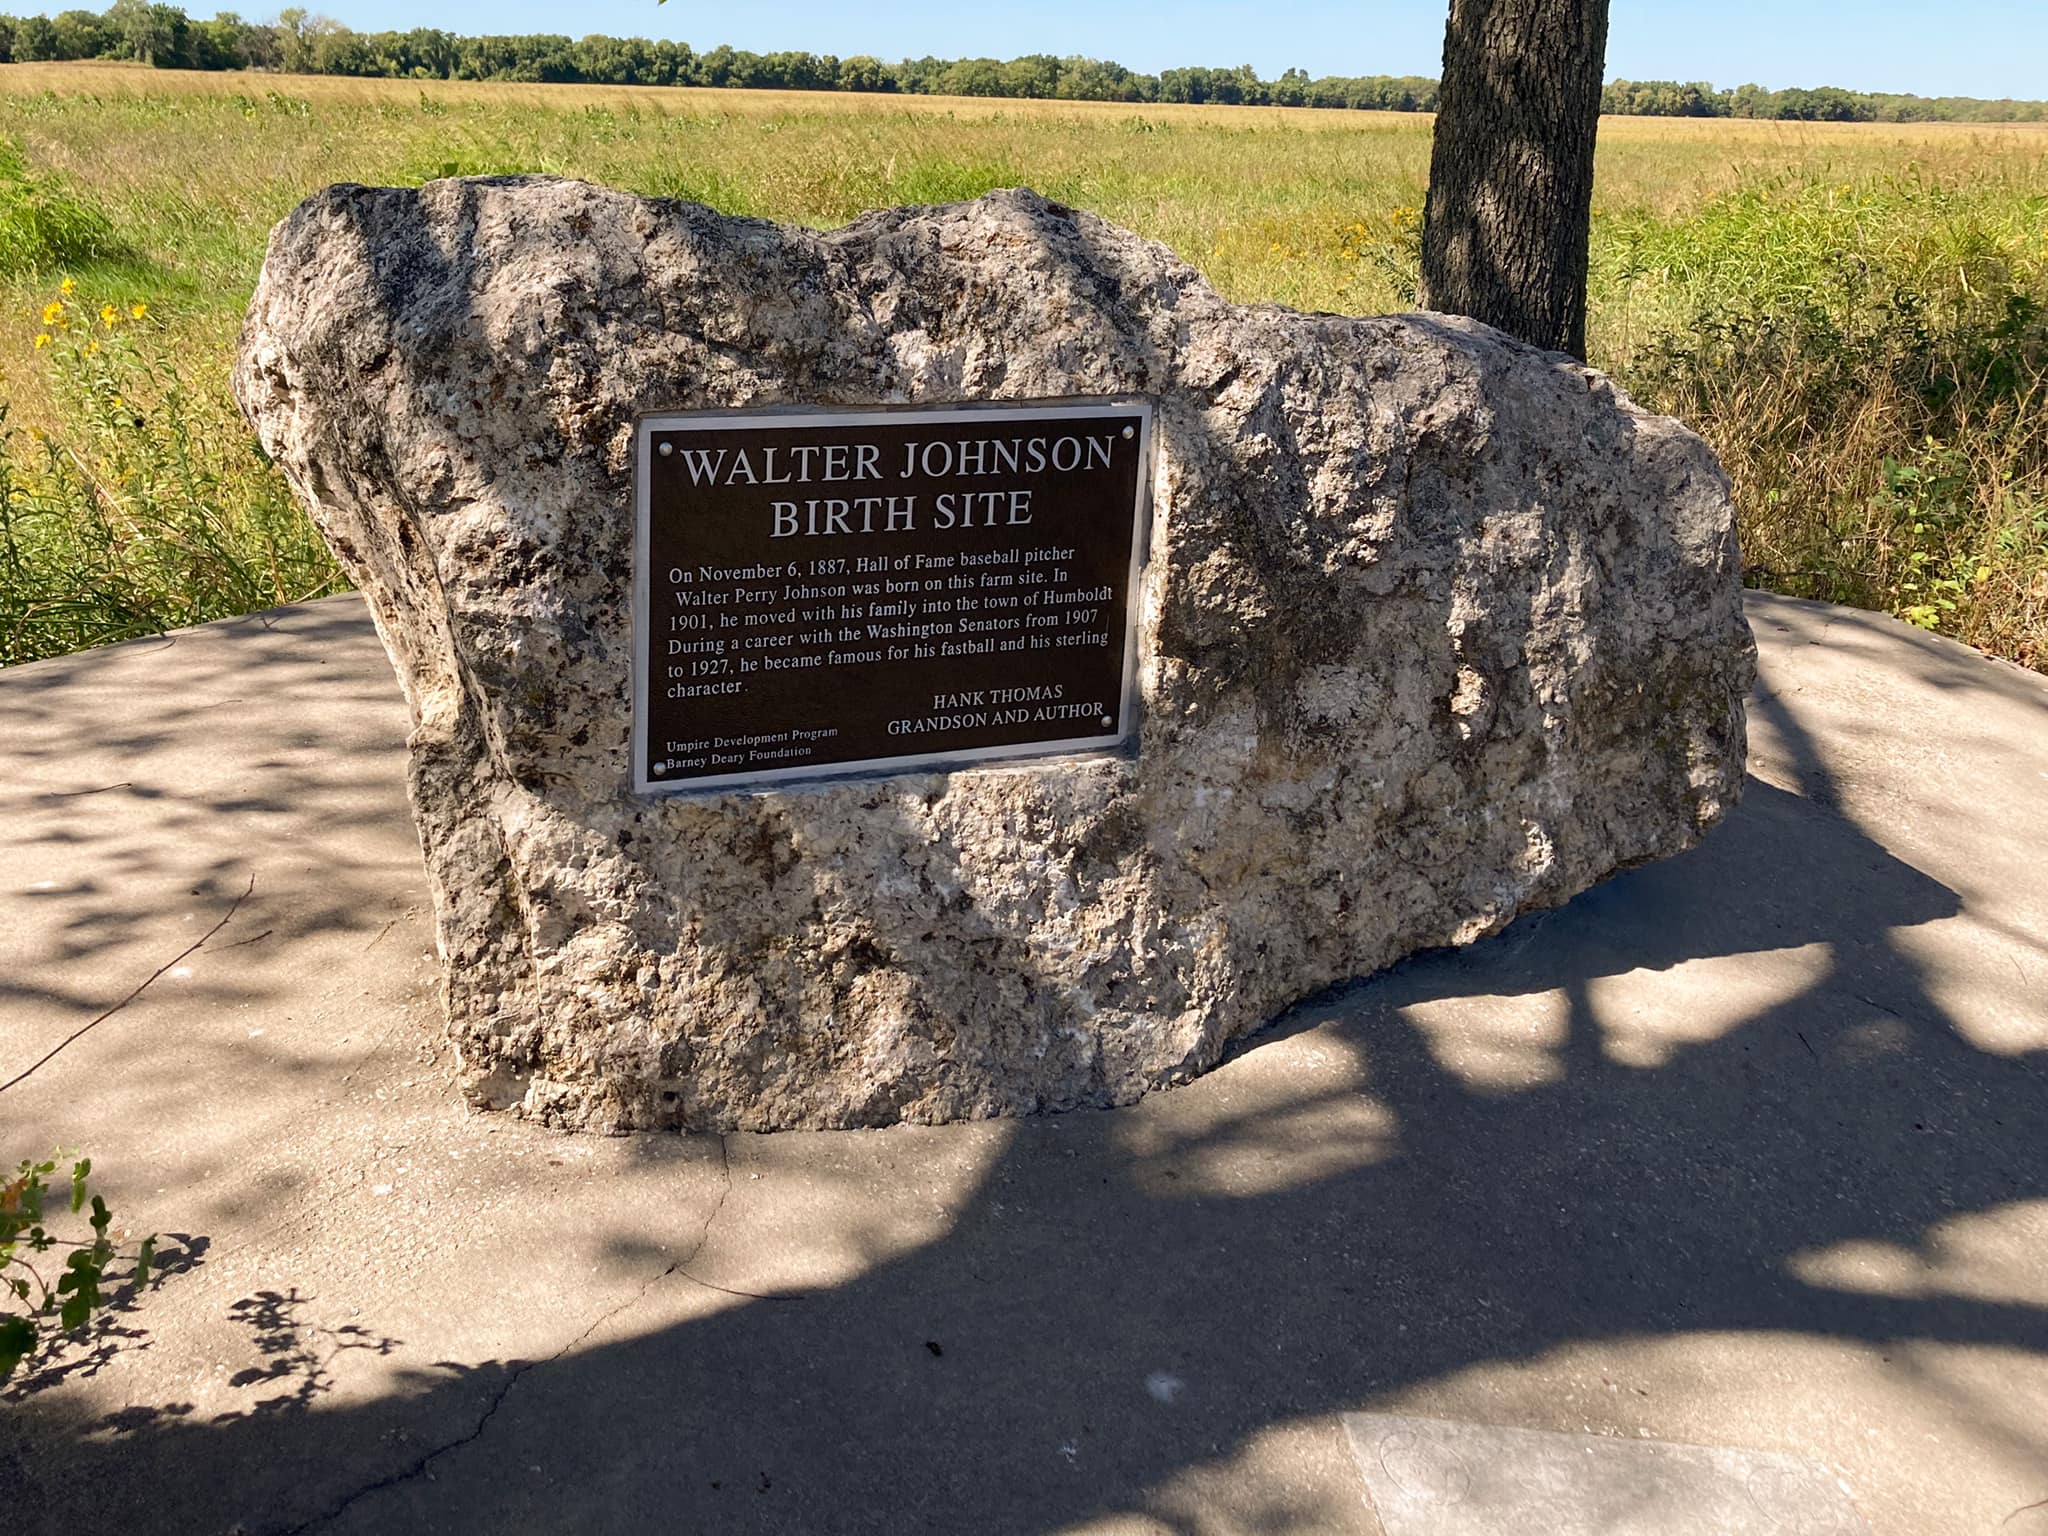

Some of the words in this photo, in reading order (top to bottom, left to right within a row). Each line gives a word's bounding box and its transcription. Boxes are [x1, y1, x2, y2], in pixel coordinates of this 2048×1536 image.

[680, 445, 883, 486] WALTER
[900, 436, 1115, 478] JOHNSON
[770, 496, 916, 537] BIRTH
[934, 491, 1032, 528] SITE
[670, 568, 692, 583] On
[699, 564, 782, 581] November
[788, 562, 801, 578] 6,
[810, 559, 850, 575] 1887,
[856, 556, 888, 572] Hall
[894, 555, 911, 570] of
[915, 555, 954, 568] Fame
[961, 549, 1018, 566] baseball
[1025, 546, 1075, 566] pitcher
[676, 591, 728, 606] Walter
[735, 589, 777, 604] Perry
[784, 585, 845, 600] Johnson
[852, 584, 879, 594] was
[886, 579, 918, 593] born
[925, 580, 942, 590] on
[949, 574, 974, 589] this
[981, 573, 1012, 586] farm
[1019, 570, 1047, 584] site.
[1054, 568, 1067, 582] In
[671, 615, 713, 630] 1901,
[721, 613, 738, 627] he
[745, 608, 795, 625] moved
[802, 606, 834, 620] with
[841, 604, 862, 618] his
[869, 600, 916, 618] family
[923, 599, 951, 613] into
[957, 597, 978, 610] the
[984, 597, 1017, 608] town
[1024, 592, 1039, 605] of
[1044, 586, 1112, 604] Humboldt
[669, 638, 724, 654] During
[731, 639, 738, 649] a
[746, 635, 793, 648] career
[800, 629, 832, 643] with
[839, 627, 860, 641] the
[867, 622, 952, 639] Washington
[959, 618, 1019, 632] Senators
[1026, 614, 1058, 627] from
[1066, 609, 1097, 624] 1907
[669, 666, 683, 677] to
[692, 659, 733, 676] 1927,
[741, 658, 757, 672] he
[765, 656, 821, 670] became
[828, 650, 881, 664] famous
[888, 646, 909, 660] for
[914, 643, 935, 658] his
[941, 638, 994, 656] fastball
[1000, 636, 1024, 650] and
[1031, 635, 1050, 648] his
[1056, 631, 1108, 646] sterling
[668, 682, 747, 698] character.
[934, 691, 984, 709] HANK
[990, 685, 1062, 703] THOMAS
[888, 713, 987, 734] GRANDSON
[992, 709, 1029, 725] AND
[1034, 703, 1103, 721] AUTHOR
[667, 740, 709, 753] Umpire
[715, 733, 787, 749] Development
[793, 729, 837, 740] Program
[667, 758, 707, 768] Barney
[712, 754, 744, 764] Deary
[750, 745, 811, 760] Foundation
